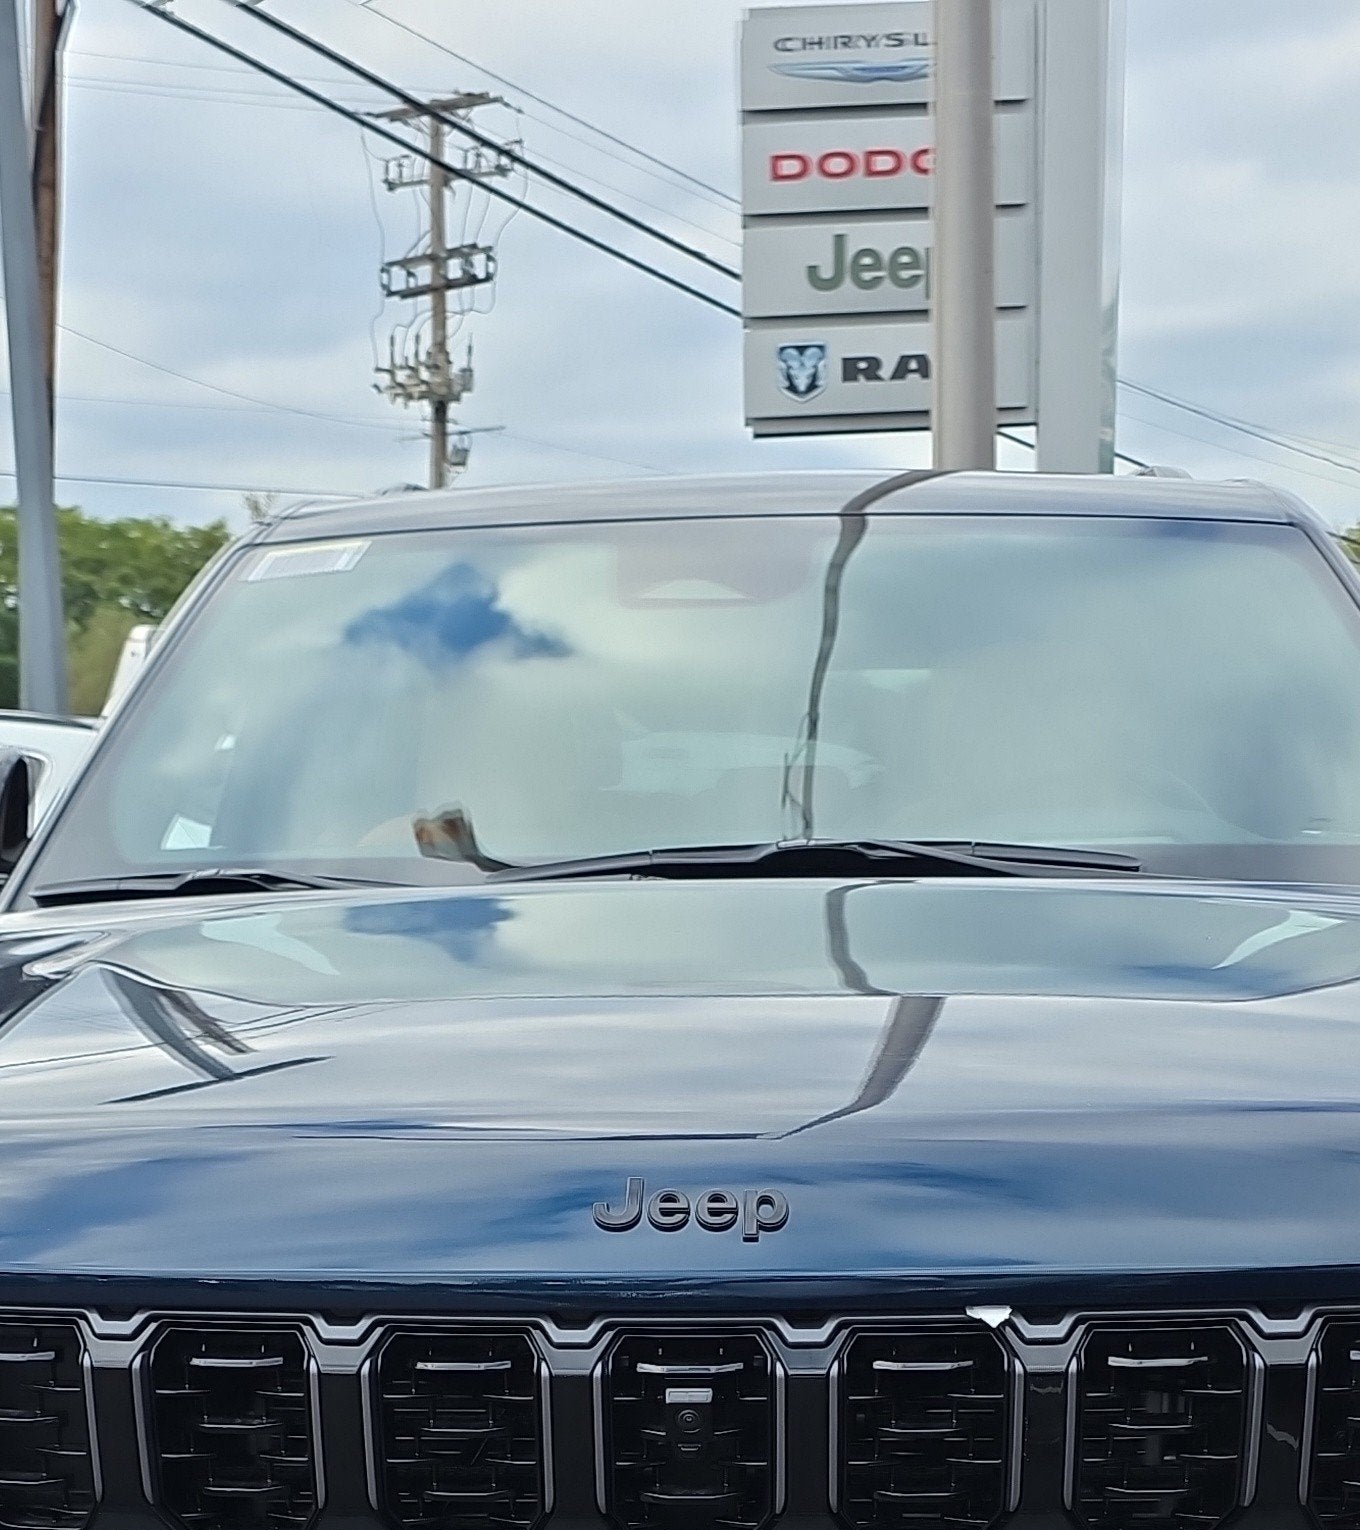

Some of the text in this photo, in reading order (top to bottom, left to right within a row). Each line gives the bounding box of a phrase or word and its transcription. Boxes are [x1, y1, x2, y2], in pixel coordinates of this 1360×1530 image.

[773, 32, 933, 52] CHRYSL
[807, 233, 932, 300] Jee
[841, 354, 930, 383] RA
[592, 1177, 789, 1242] Jeep
